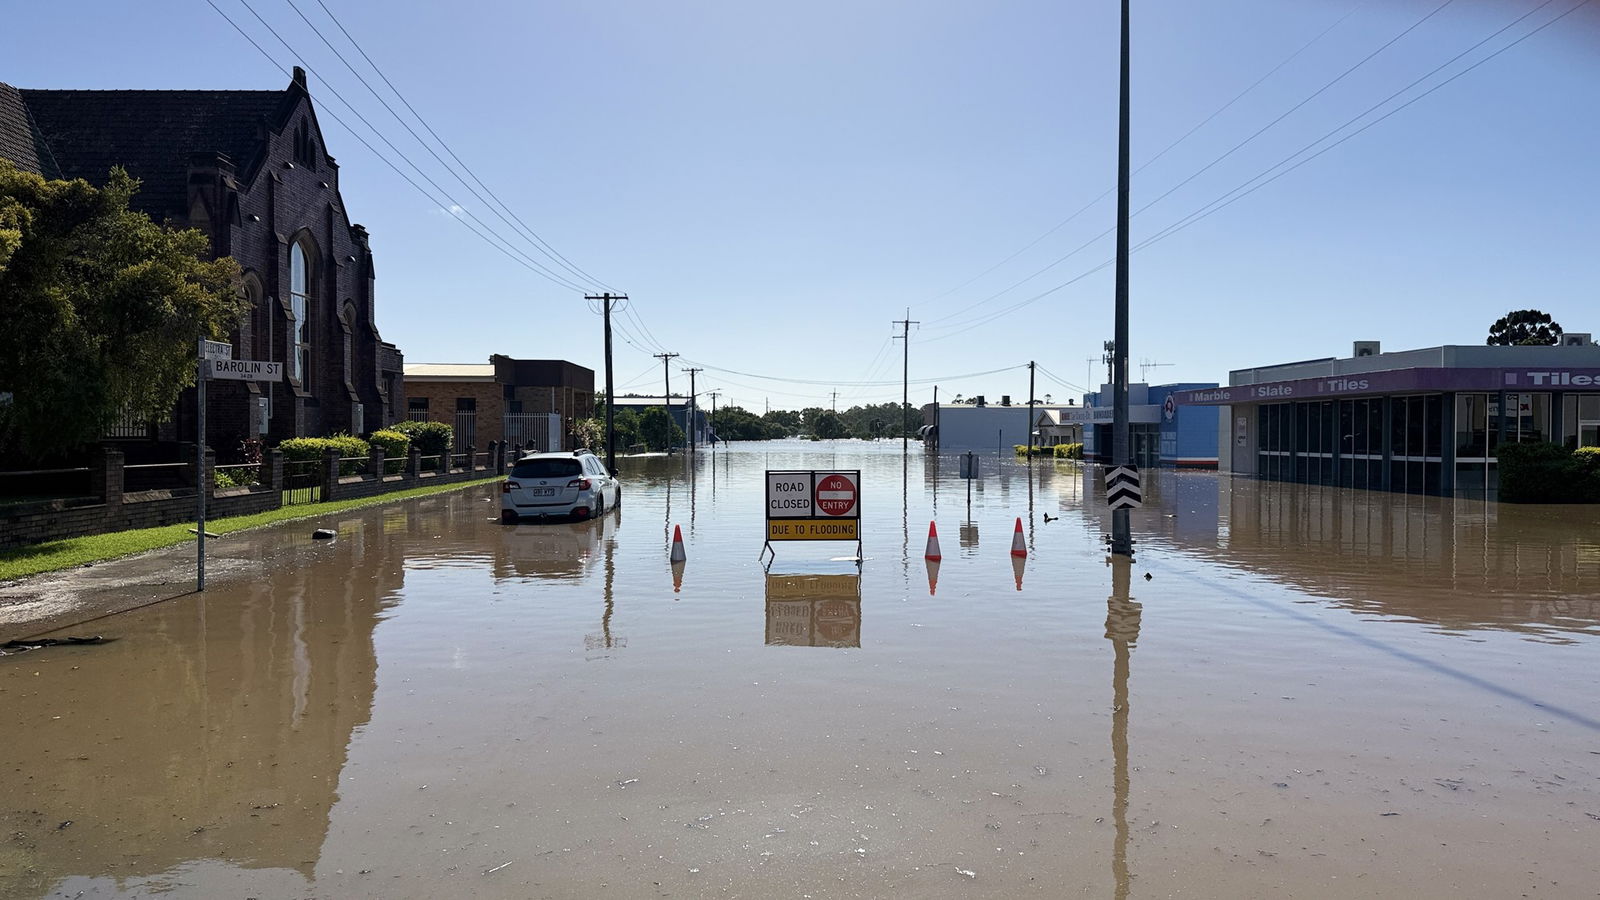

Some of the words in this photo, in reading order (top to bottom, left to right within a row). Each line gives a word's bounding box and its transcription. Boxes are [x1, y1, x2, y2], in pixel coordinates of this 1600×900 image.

[216, 361, 260, 373] BAROLIN
[266, 364, 279, 374] ST
[1327, 379, 1369, 391] Tiles
[1258, 385, 1292, 397] Slate
[1194, 391, 1230, 402] Marble
[775, 482, 804, 492] ROAD
[830, 481, 842, 489] NO
[770, 499, 810, 509] CLOSED
[822, 501, 849, 510] ENTRY
[772, 525, 789, 535] DUE
[795, 525, 805, 534] TO
[810, 525, 854, 534] FLOODING
